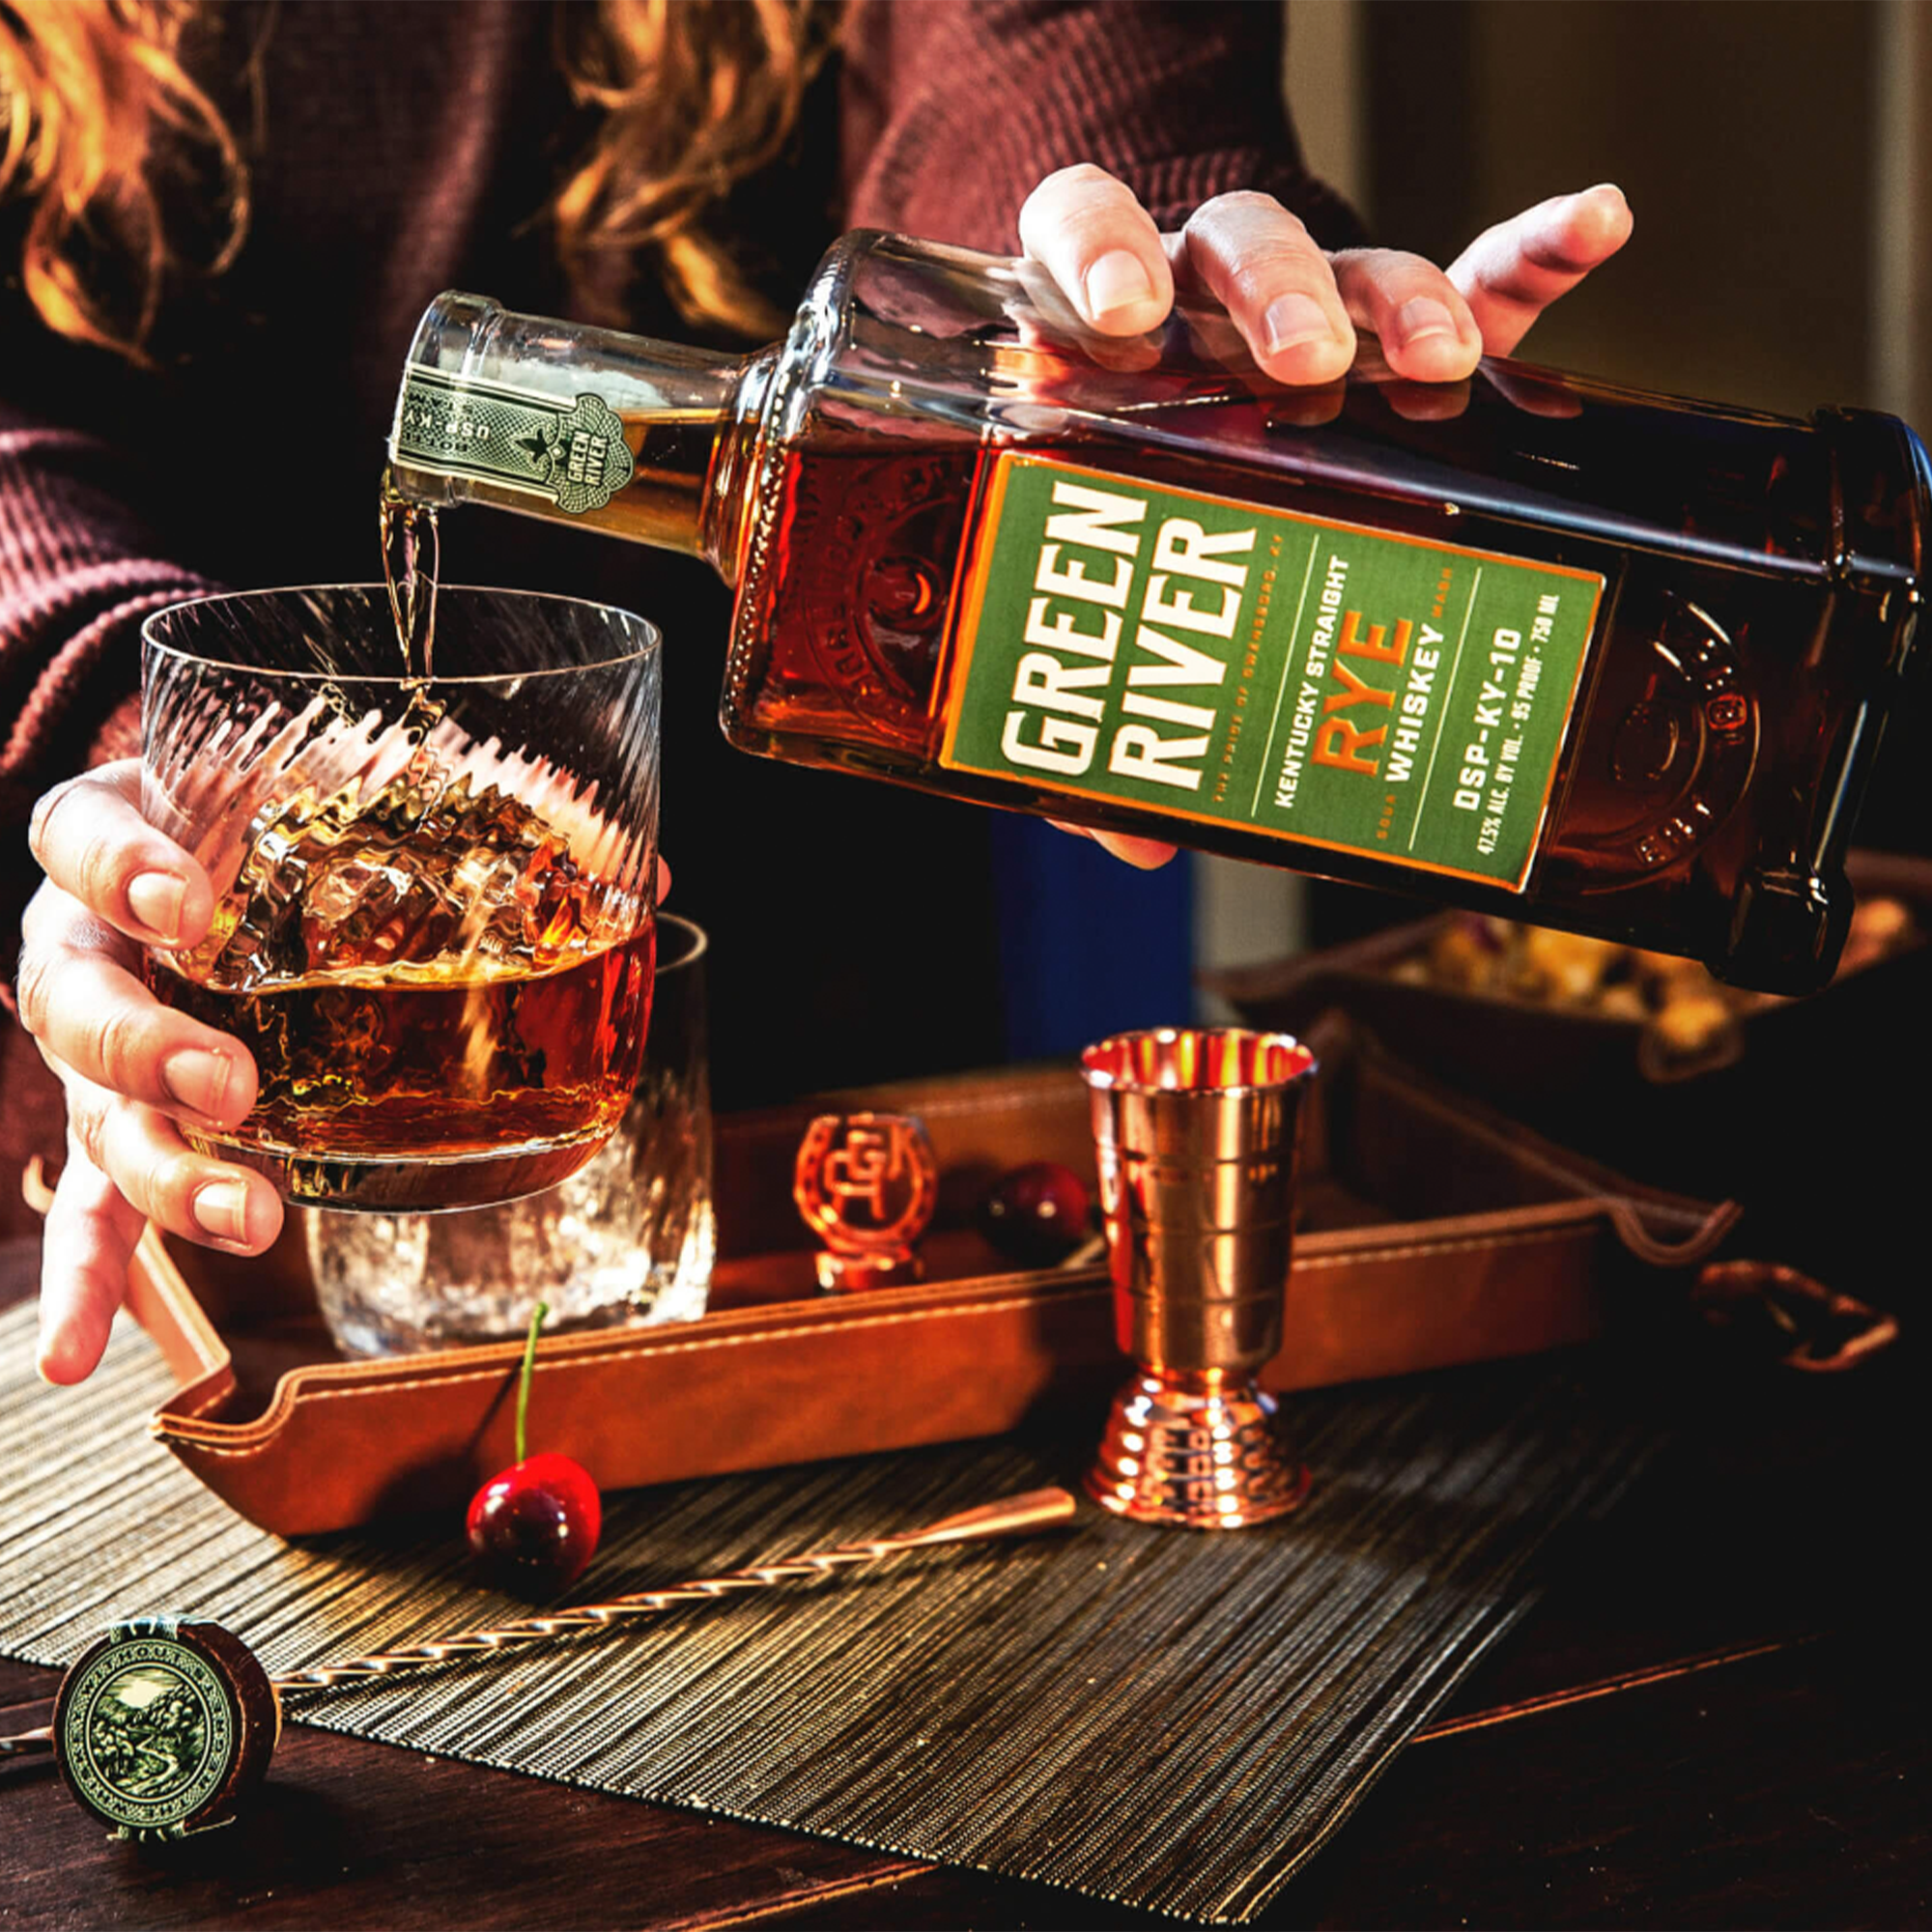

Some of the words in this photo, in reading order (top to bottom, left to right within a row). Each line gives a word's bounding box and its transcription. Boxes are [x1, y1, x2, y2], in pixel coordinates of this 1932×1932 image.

[567, 430, 590, 483] GREEN
[584, 435, 608, 486] RIVER
[1432, 567, 1453, 618] MASH
[1538, 593, 1560, 617] ML
[1001, 480, 1148, 777] GREEN
[1108, 517, 1257, 790] RIVER
[1530, 617, 1553, 643] 750
[1212, 772, 1230, 803] THE
[1222, 715, 1242, 764] PRIDE
[1236, 686, 1249, 707] OF
[1269, 534, 1283, 557] KY
[1274, 680, 1320, 809] KENTUCKY
[1305, 554, 1349, 678] STRAIGHT
[1310, 609, 1413, 778] RYE
[1516, 654, 1543, 700] PROOF
[1384, 623, 1444, 782] WHISKEY
[1453, 627, 1521, 811] DSP-KY-10
[1510, 700, 1531, 722] 95
[1499, 733, 1523, 762] VOL.
[1494, 763, 1516, 784] BY
[1376, 794, 1396, 839] SOUR
[1487, 786, 1511, 815] ALC.
[1476, 816, 1503, 856] 47.5%
[81, 1646, 182, 1695] WITHOUT
